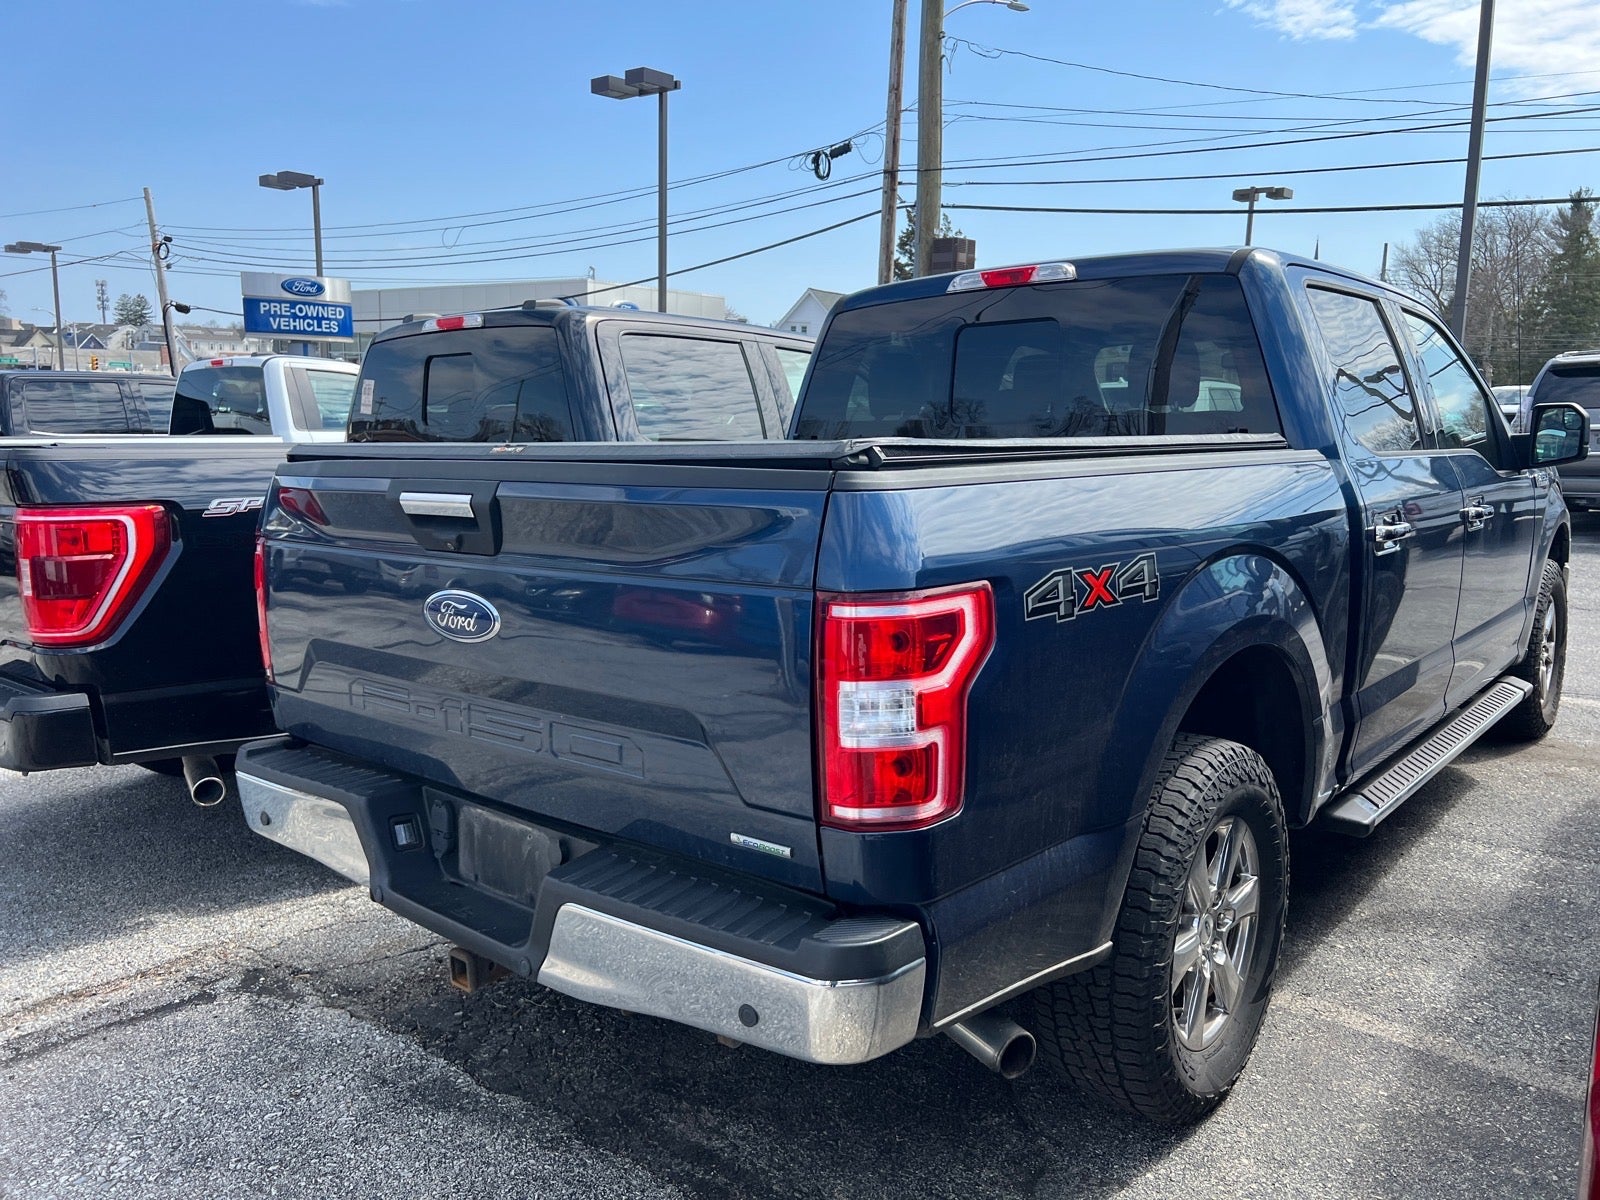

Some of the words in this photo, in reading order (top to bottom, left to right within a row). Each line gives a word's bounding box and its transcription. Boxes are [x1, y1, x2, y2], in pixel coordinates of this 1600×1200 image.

[292, 281, 318, 293] Ford
[260, 302, 345, 319] PRE-OWNED
[269, 317, 339, 333] VEHICLES
[437, 600, 478, 632] Ford
[350, 677, 645, 779] F-150
